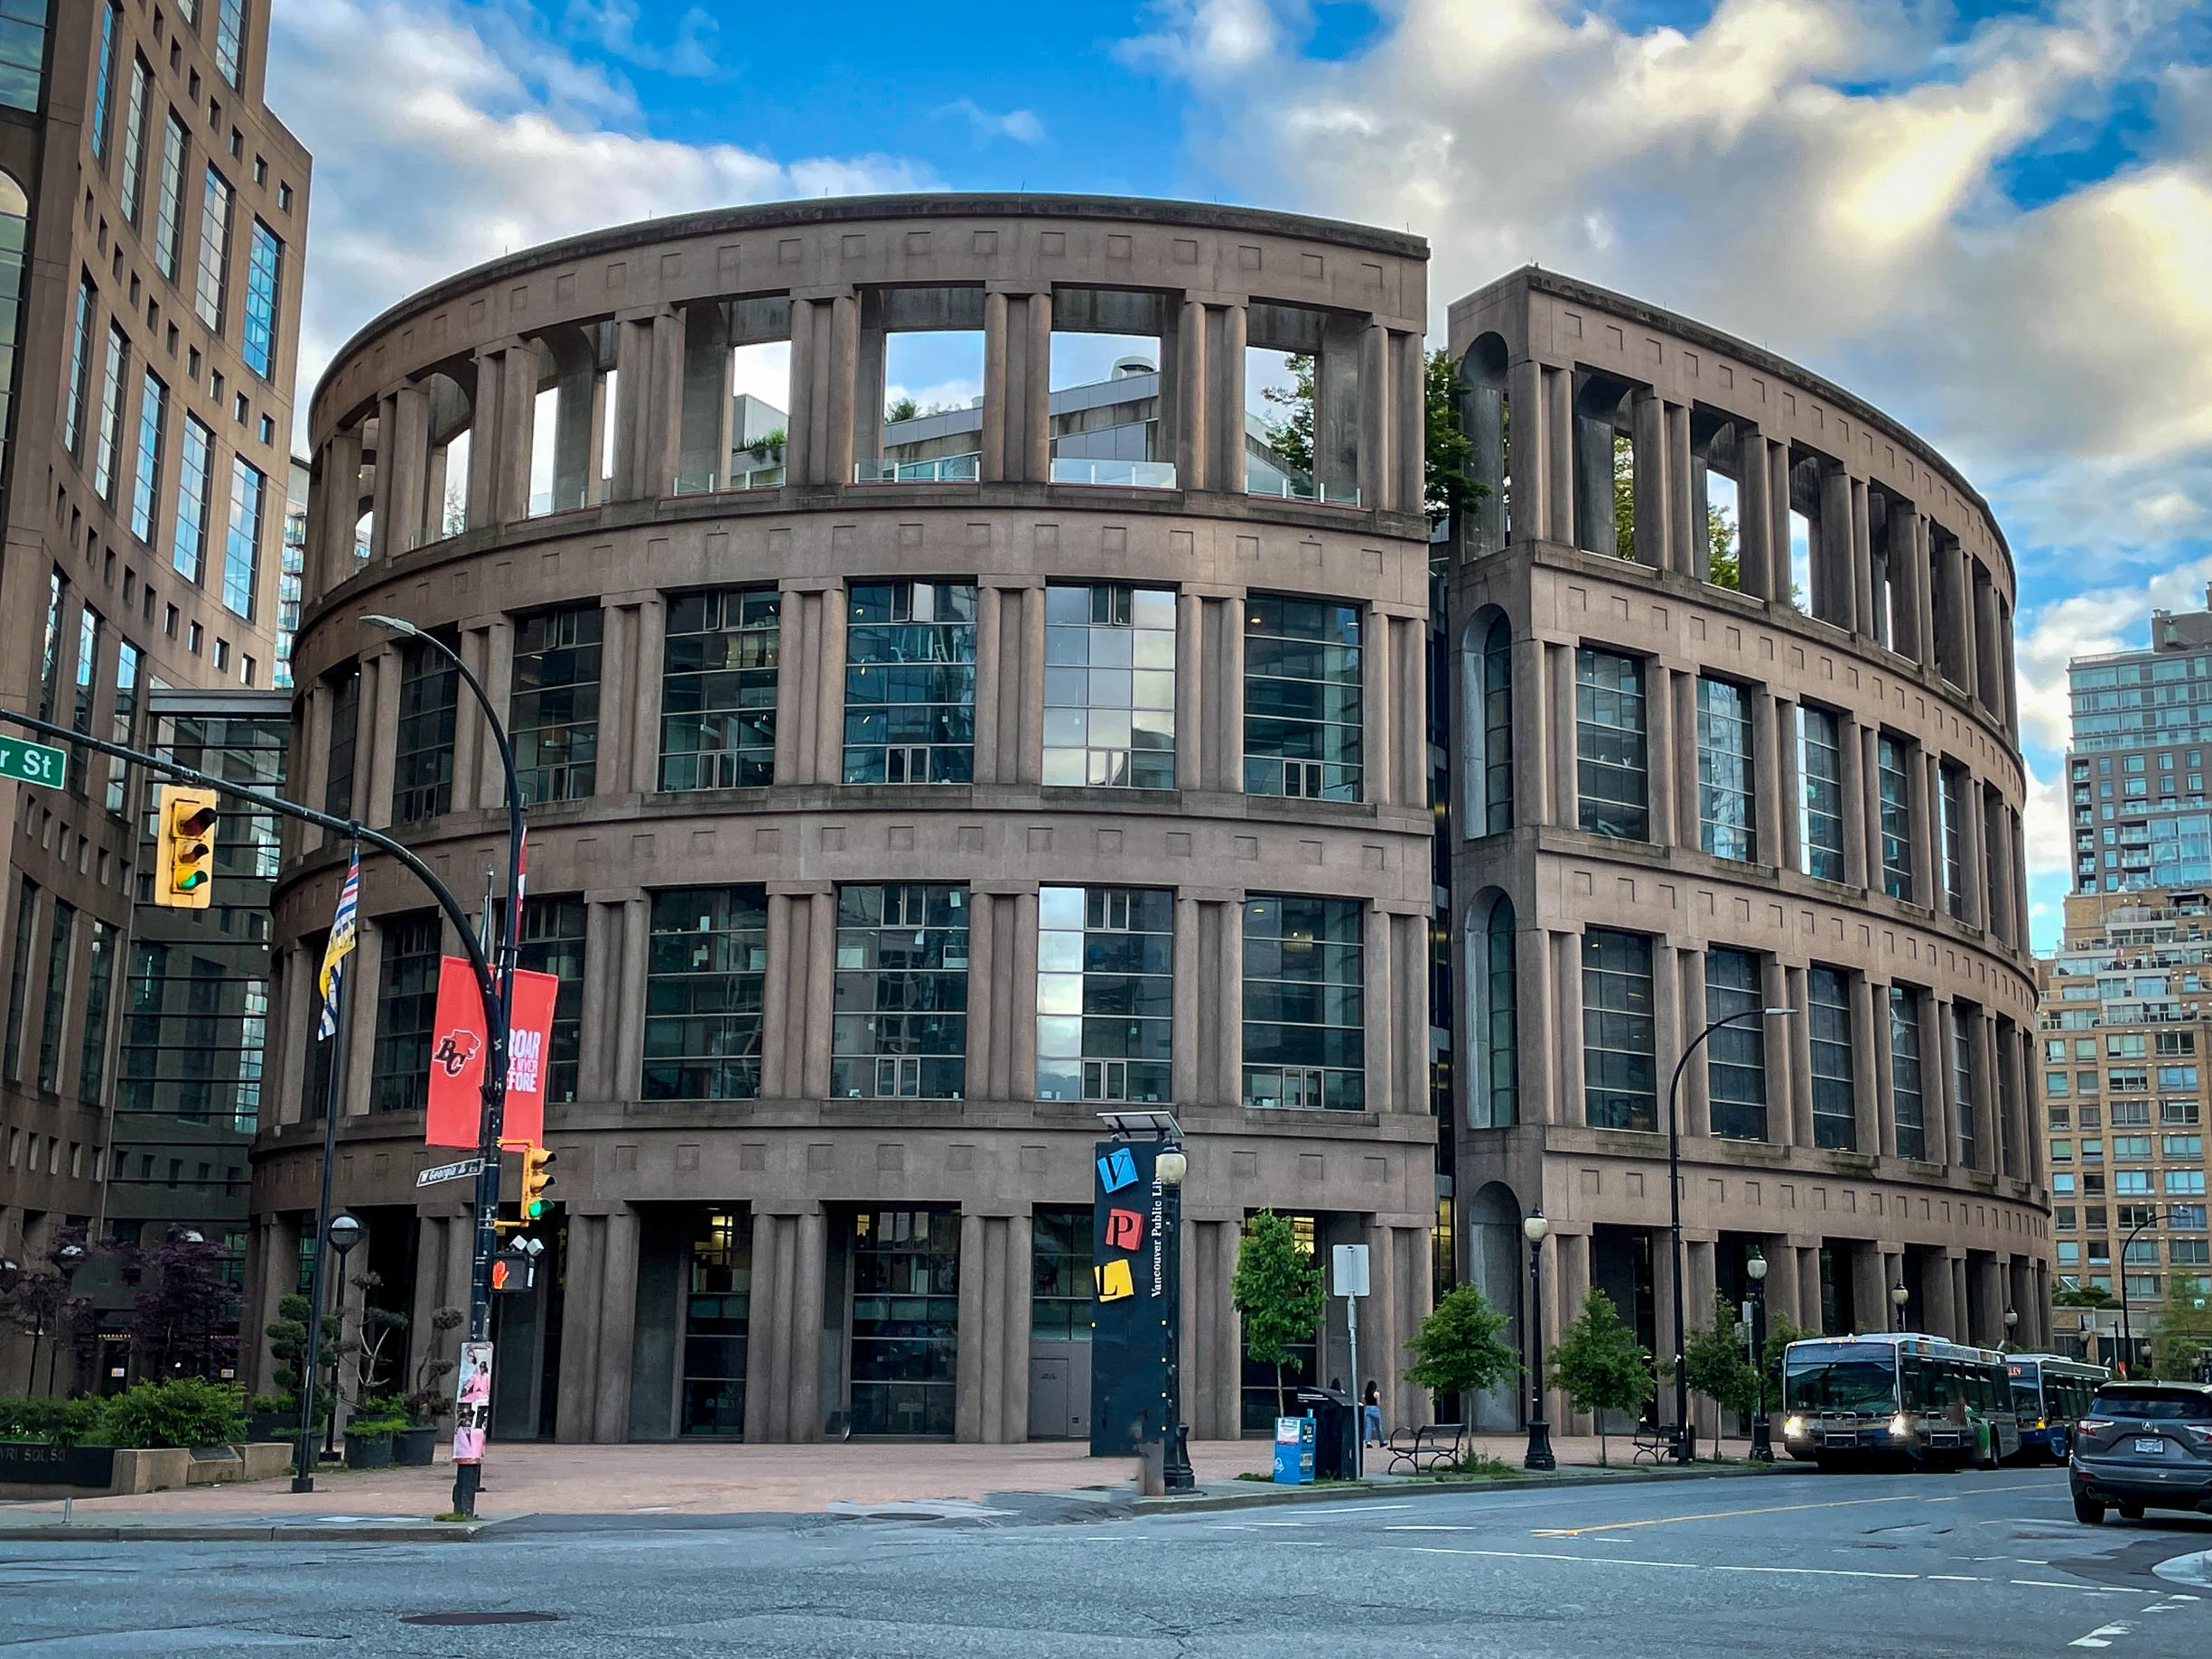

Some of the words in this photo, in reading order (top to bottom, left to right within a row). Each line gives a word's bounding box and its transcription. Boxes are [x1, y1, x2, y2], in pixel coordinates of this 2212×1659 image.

[23, 750, 51, 778] St
[429, 1166, 457, 1179] Georgia
[1152, 1200, 1162, 1237] Public
[1152, 1240, 1162, 1298] Vancouver
